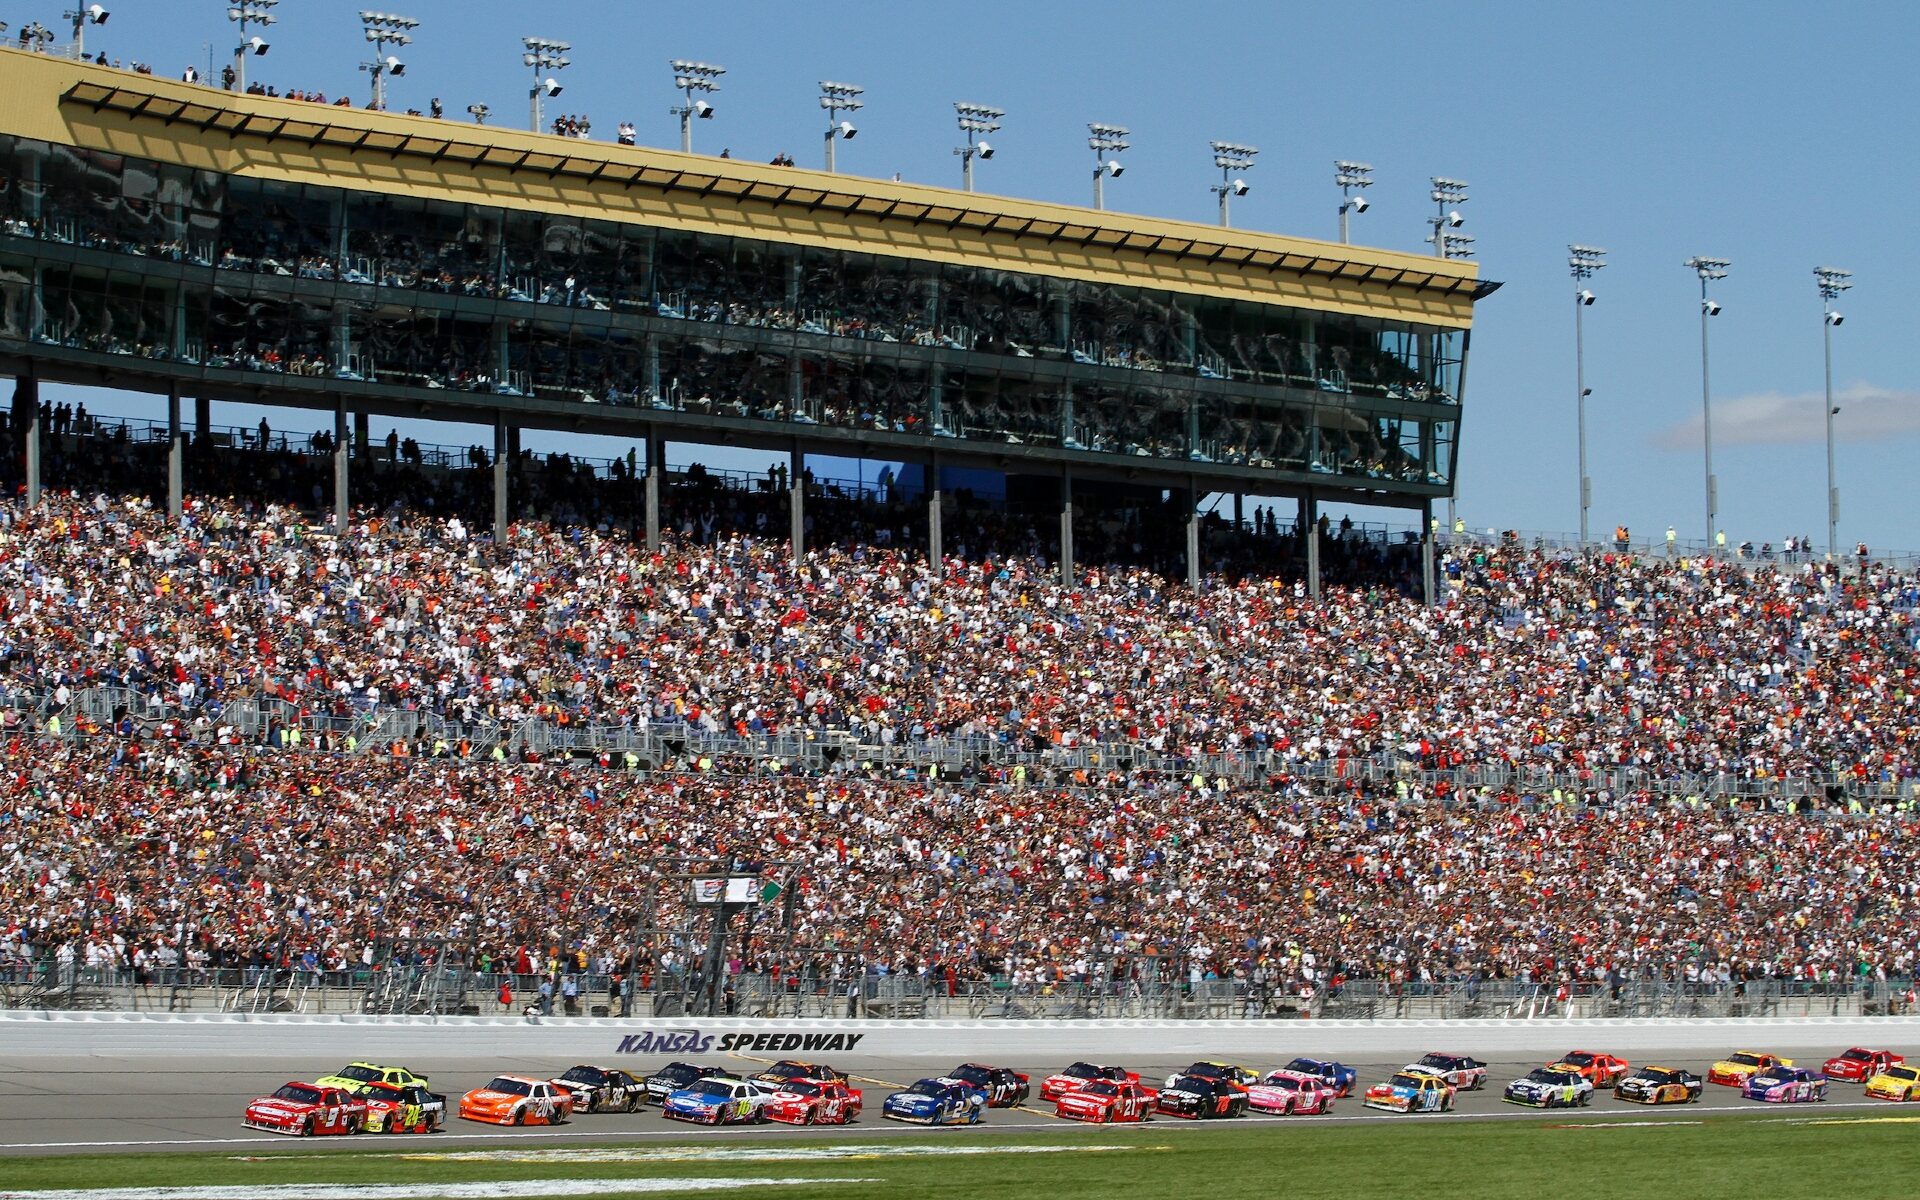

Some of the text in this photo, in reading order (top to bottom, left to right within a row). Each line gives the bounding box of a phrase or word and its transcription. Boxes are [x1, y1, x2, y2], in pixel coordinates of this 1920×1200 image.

[616, 1028, 866, 1054] KANSAS SPEEDWAY
[1876, 1063, 1887, 1075] 12
[609, 1087, 625, 1105] 39
[994, 1085, 1006, 1101] 11
[1425, 1091, 1438, 1108] 18
[405, 1104, 420, 1126] 24
[535, 1099, 549, 1117] 20
[736, 1099, 751, 1117] 16
[825, 1099, 840, 1116] 42
[952, 1101, 965, 1118] 2
[1123, 1099, 1136, 1116] 21
[325, 1107, 340, 1127] 9
